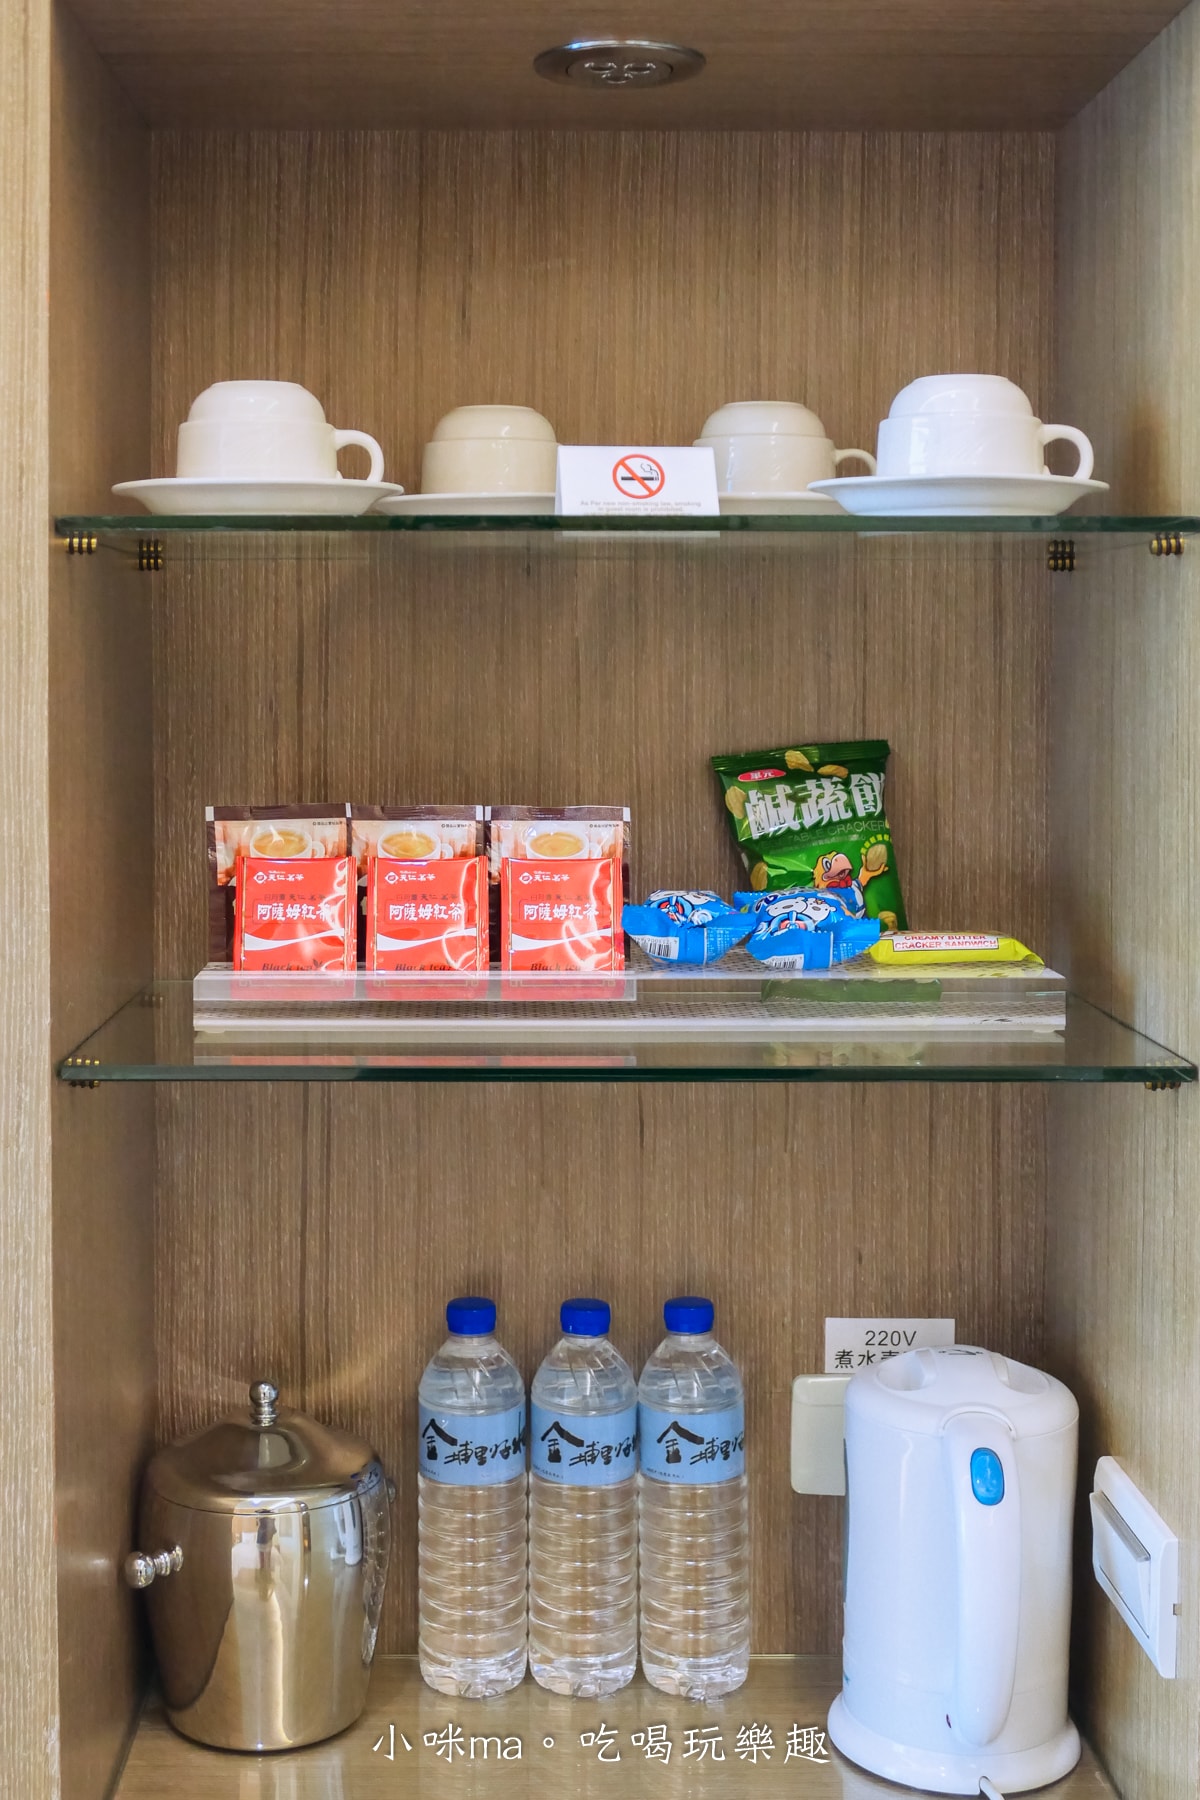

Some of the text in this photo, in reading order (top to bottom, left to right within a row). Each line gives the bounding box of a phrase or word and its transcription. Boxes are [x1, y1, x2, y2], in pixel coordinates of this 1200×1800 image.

[389, 903, 465, 921] 阿薩姆紅茶
[895, 940, 997, 949] CRACKER SANDWICH
[864, 1330, 917, 1347] 220V
[568, 1433, 637, 1467] 埔里好
